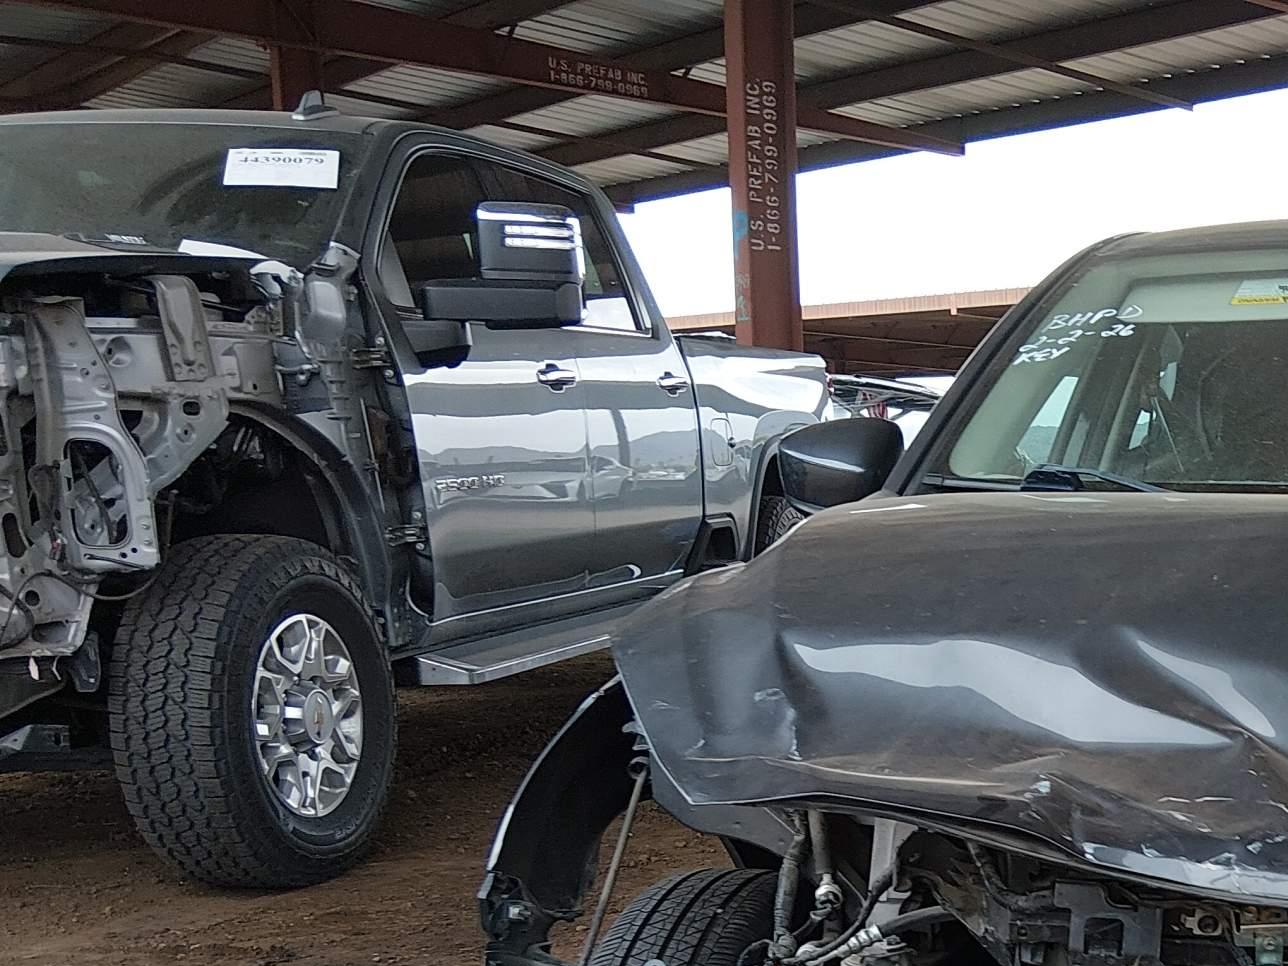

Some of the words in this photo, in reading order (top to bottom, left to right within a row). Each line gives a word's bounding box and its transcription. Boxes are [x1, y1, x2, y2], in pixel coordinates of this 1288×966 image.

[548, 56, 572, 72] U.S.
[577, 62, 622, 80] PREFAB
[627, 71, 648, 86] INC.
[745, 78, 761, 115] INC.
[747, 126, 763, 202] PREFAB
[762, 81, 782, 251] 1-866-799-0969
[750, 214, 765, 251] U.S.
[1012, 347, 1070, 366] KEY
